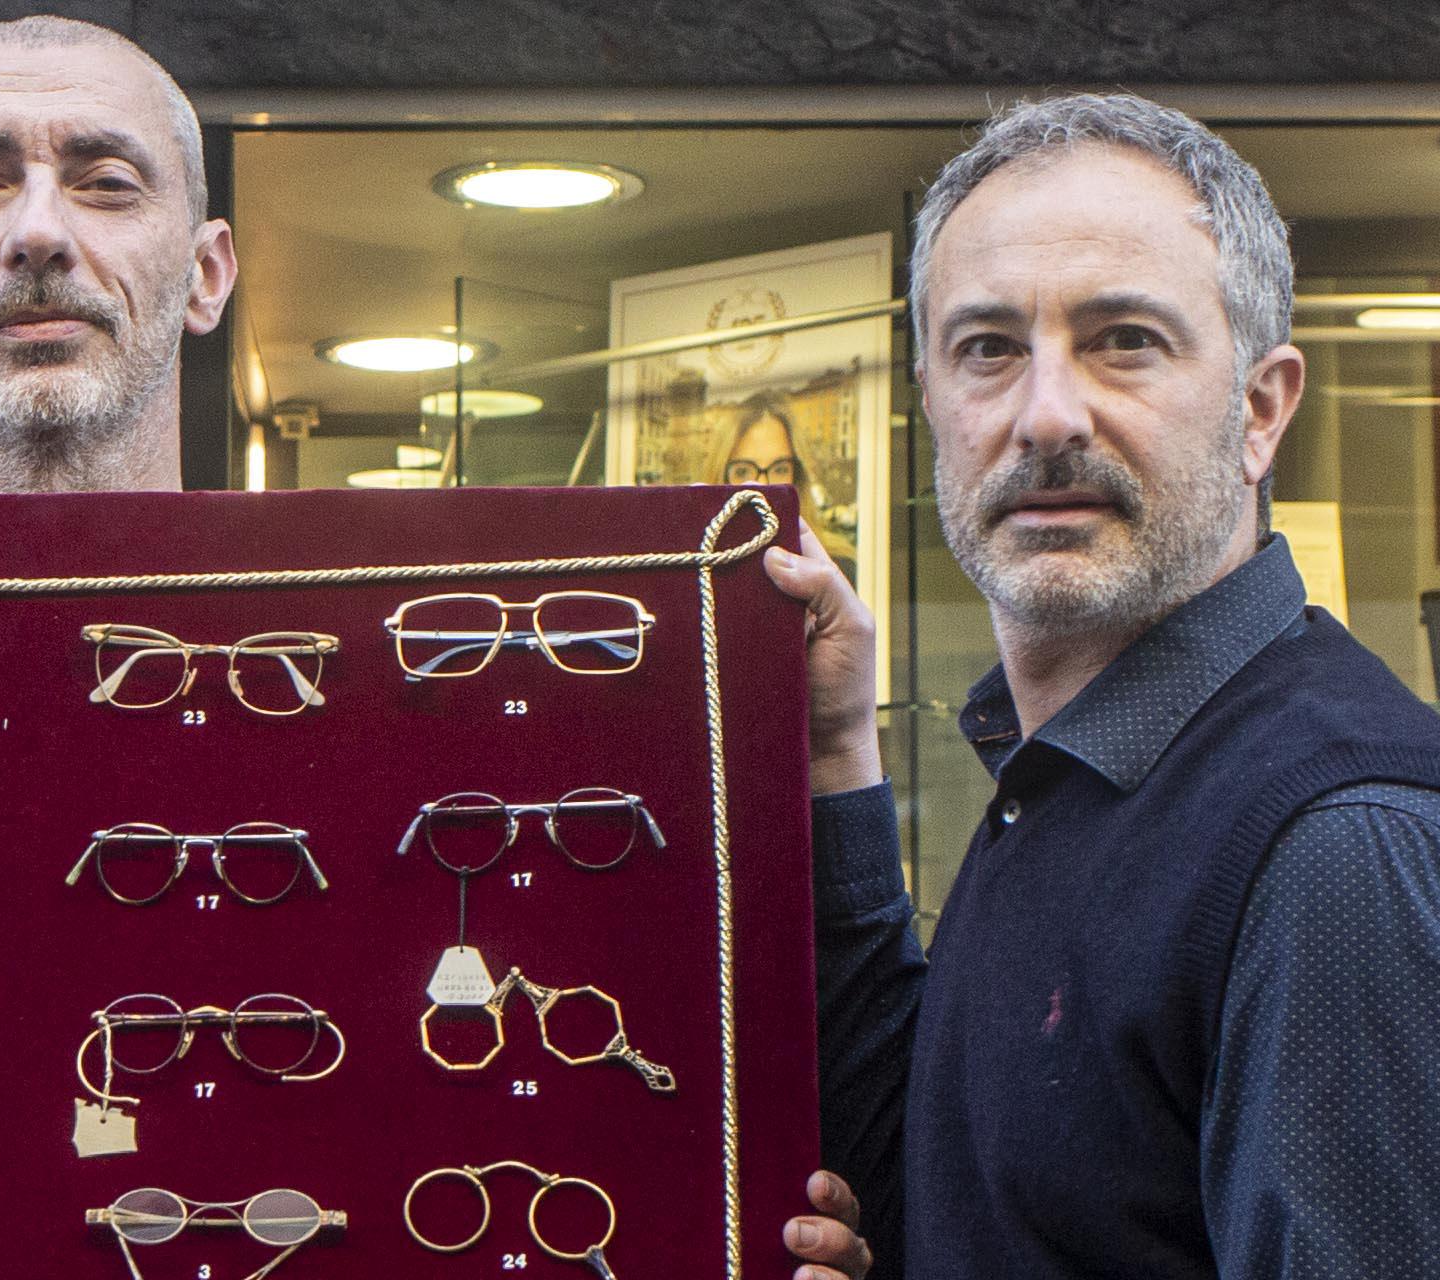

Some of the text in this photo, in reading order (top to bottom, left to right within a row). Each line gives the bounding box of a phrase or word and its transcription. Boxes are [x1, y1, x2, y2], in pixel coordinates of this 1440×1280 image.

[504, 699, 529, 715] 23
[182, 709, 207, 725] 23
[510, 871, 533, 888] 17
[196, 894, 220, 910] 17
[194, 1081, 216, 1099] 17
[512, 1080, 538, 1096] 25
[502, 1253, 528, 1270] 24
[197, 1263, 212, 1280] 3
